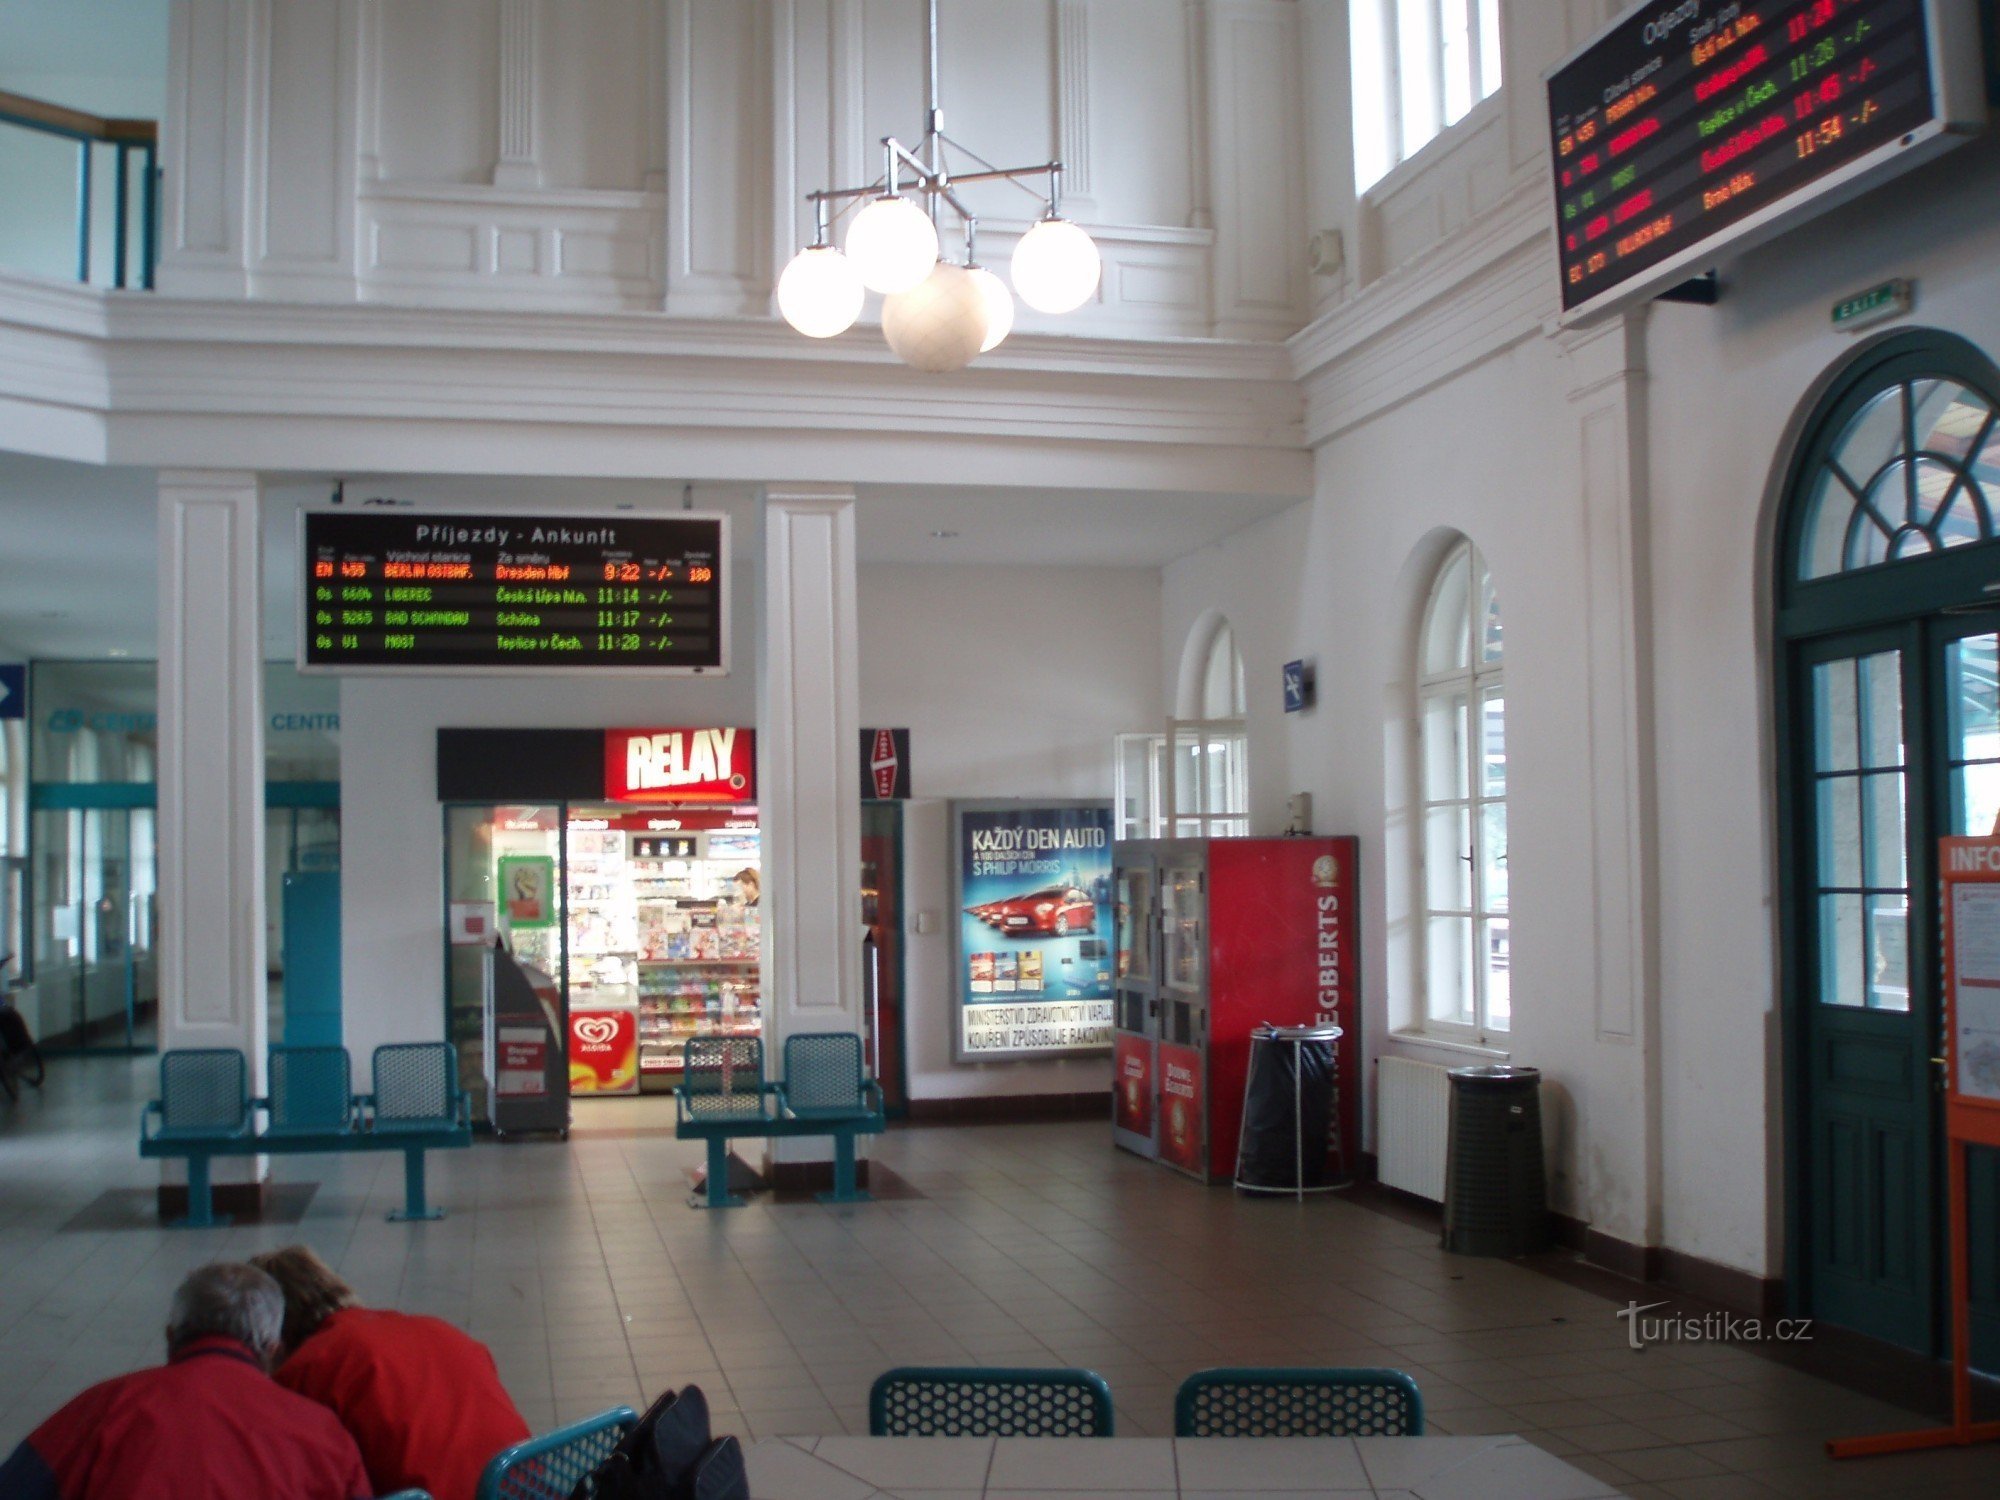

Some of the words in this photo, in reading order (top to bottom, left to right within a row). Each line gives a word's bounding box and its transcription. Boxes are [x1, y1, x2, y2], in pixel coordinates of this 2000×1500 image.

[1797, 115, 1842, 157] 11:54
[1841, 291, 1880, 318] EXIT
[416, 525, 509, 546] Příjezdy
[531, 526, 616, 545] Ankunft
[598, 587, 640, 604] 11:14
[598, 610, 641, 627] 11:17
[598, 634, 641, 650] 11:28
[627, 727, 737, 790] RELAY
[972, 826, 1023, 850] KAŽDÝ
[1027, 828, 1060, 850] DEN
[1062, 827, 1106, 849] AUTO
[972, 861, 983, 876] S
[983, 860, 1017, 876] PHILIP
[1019, 859, 1061, 874] MORRIS
[1315, 894, 1340, 1028] EGBERTS
[967, 1007, 1025, 1027] MINISTERSTVO
[580, 1043, 612, 1053] ALGIDA
[968, 1028, 1010, 1050] KOUŘENÍ
[1012, 1026, 1067, 1048] ZPŮSOBUJE
